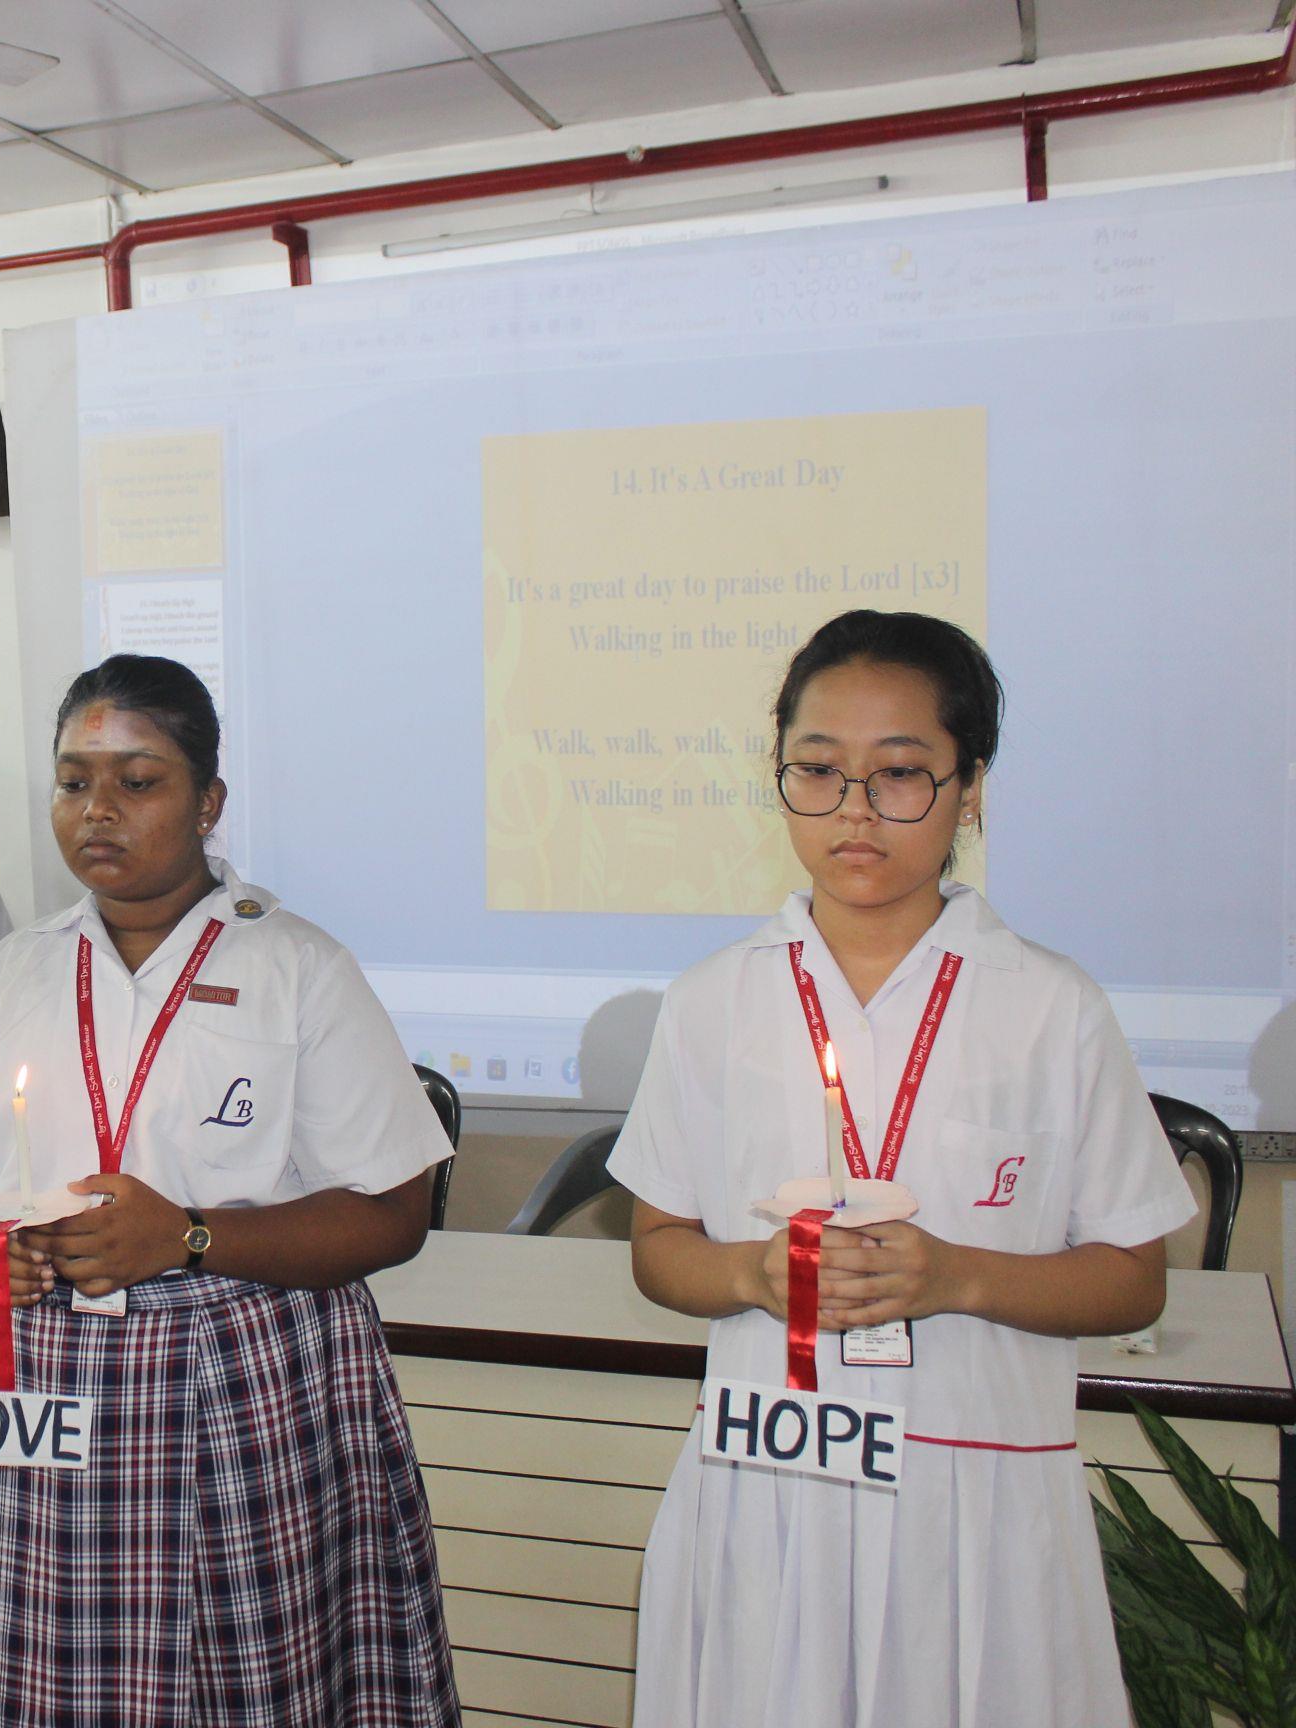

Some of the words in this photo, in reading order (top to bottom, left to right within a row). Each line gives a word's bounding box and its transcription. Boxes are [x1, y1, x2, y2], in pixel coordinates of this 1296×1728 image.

[608, 467, 641, 495] 14.
[649, 464, 688, 494] It's
[692, 466, 711, 491] A
[718, 462, 785, 490] Great
[795, 458, 846, 494] Day
[507, 576, 544, 603] It's
[550, 584, 562, 602] a
[568, 576, 626, 609] great
[634, 572, 675, 606] day
[684, 575, 705, 599] to
[715, 569, 784, 604] praise
[795, 566, 832, 595] the
[839, 562, 901, 593] Lord
[911, 560, 960, 598] [x3]
[568, 623, 662, 657] Walking
[672, 622, 692, 651] in
[704, 622, 735, 650] the
[746, 620, 798, 654] light
[532, 727, 596, 759] Walk,
[604, 728, 663, 759] walk,
[674, 728, 734, 759] walk,
[569, 779, 663, 813] Walking
[672, 781, 694, 808] in
[704, 780, 738, 807] the
[746, 780, 778, 813] lig
[716, 1387, 896, 1482] HOPE
